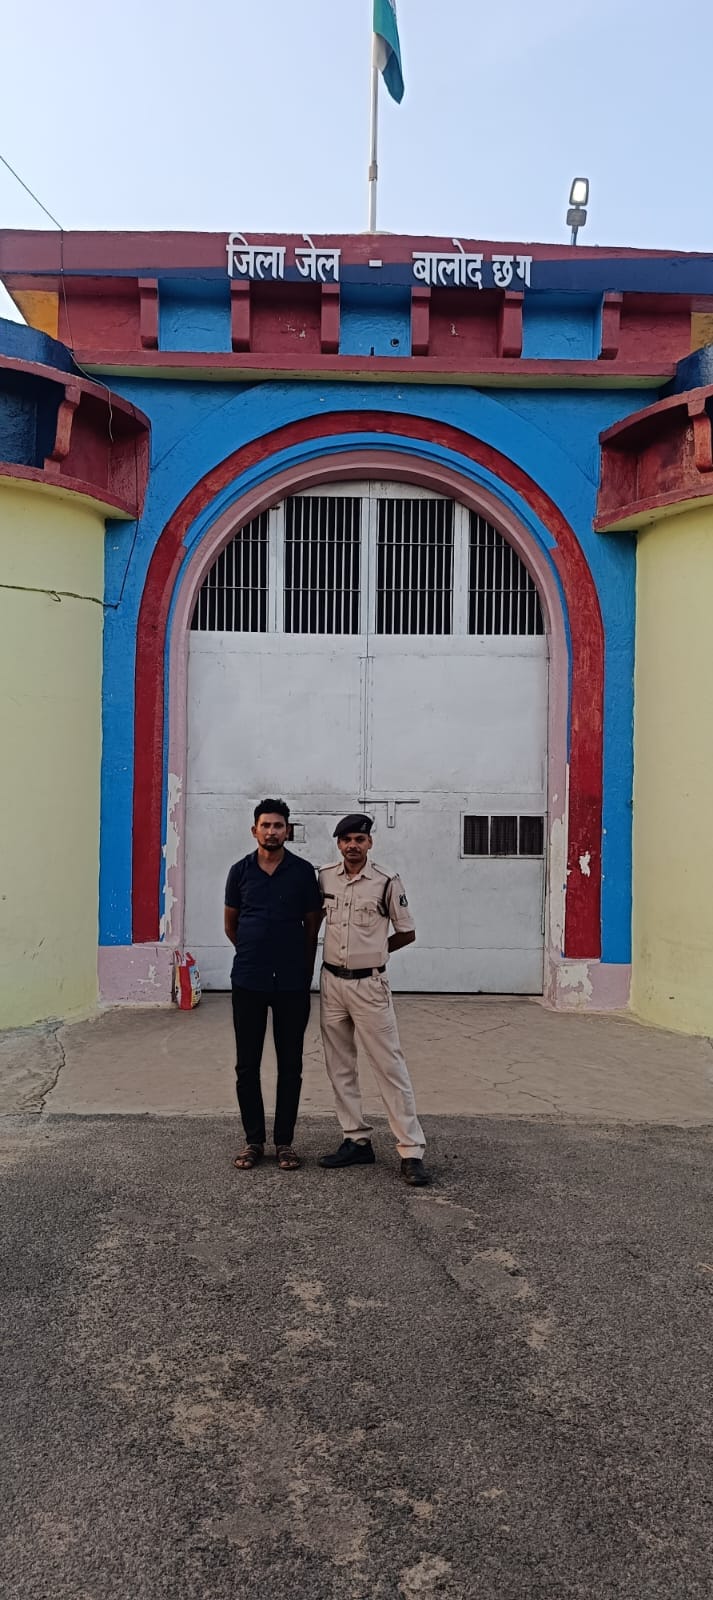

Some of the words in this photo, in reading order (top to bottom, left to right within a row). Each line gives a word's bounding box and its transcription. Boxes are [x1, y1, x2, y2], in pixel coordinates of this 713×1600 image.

[226, 233, 286, 280] जिला
[295, 234, 341, 282] जेल
[412, 239, 483, 290] बालोद
